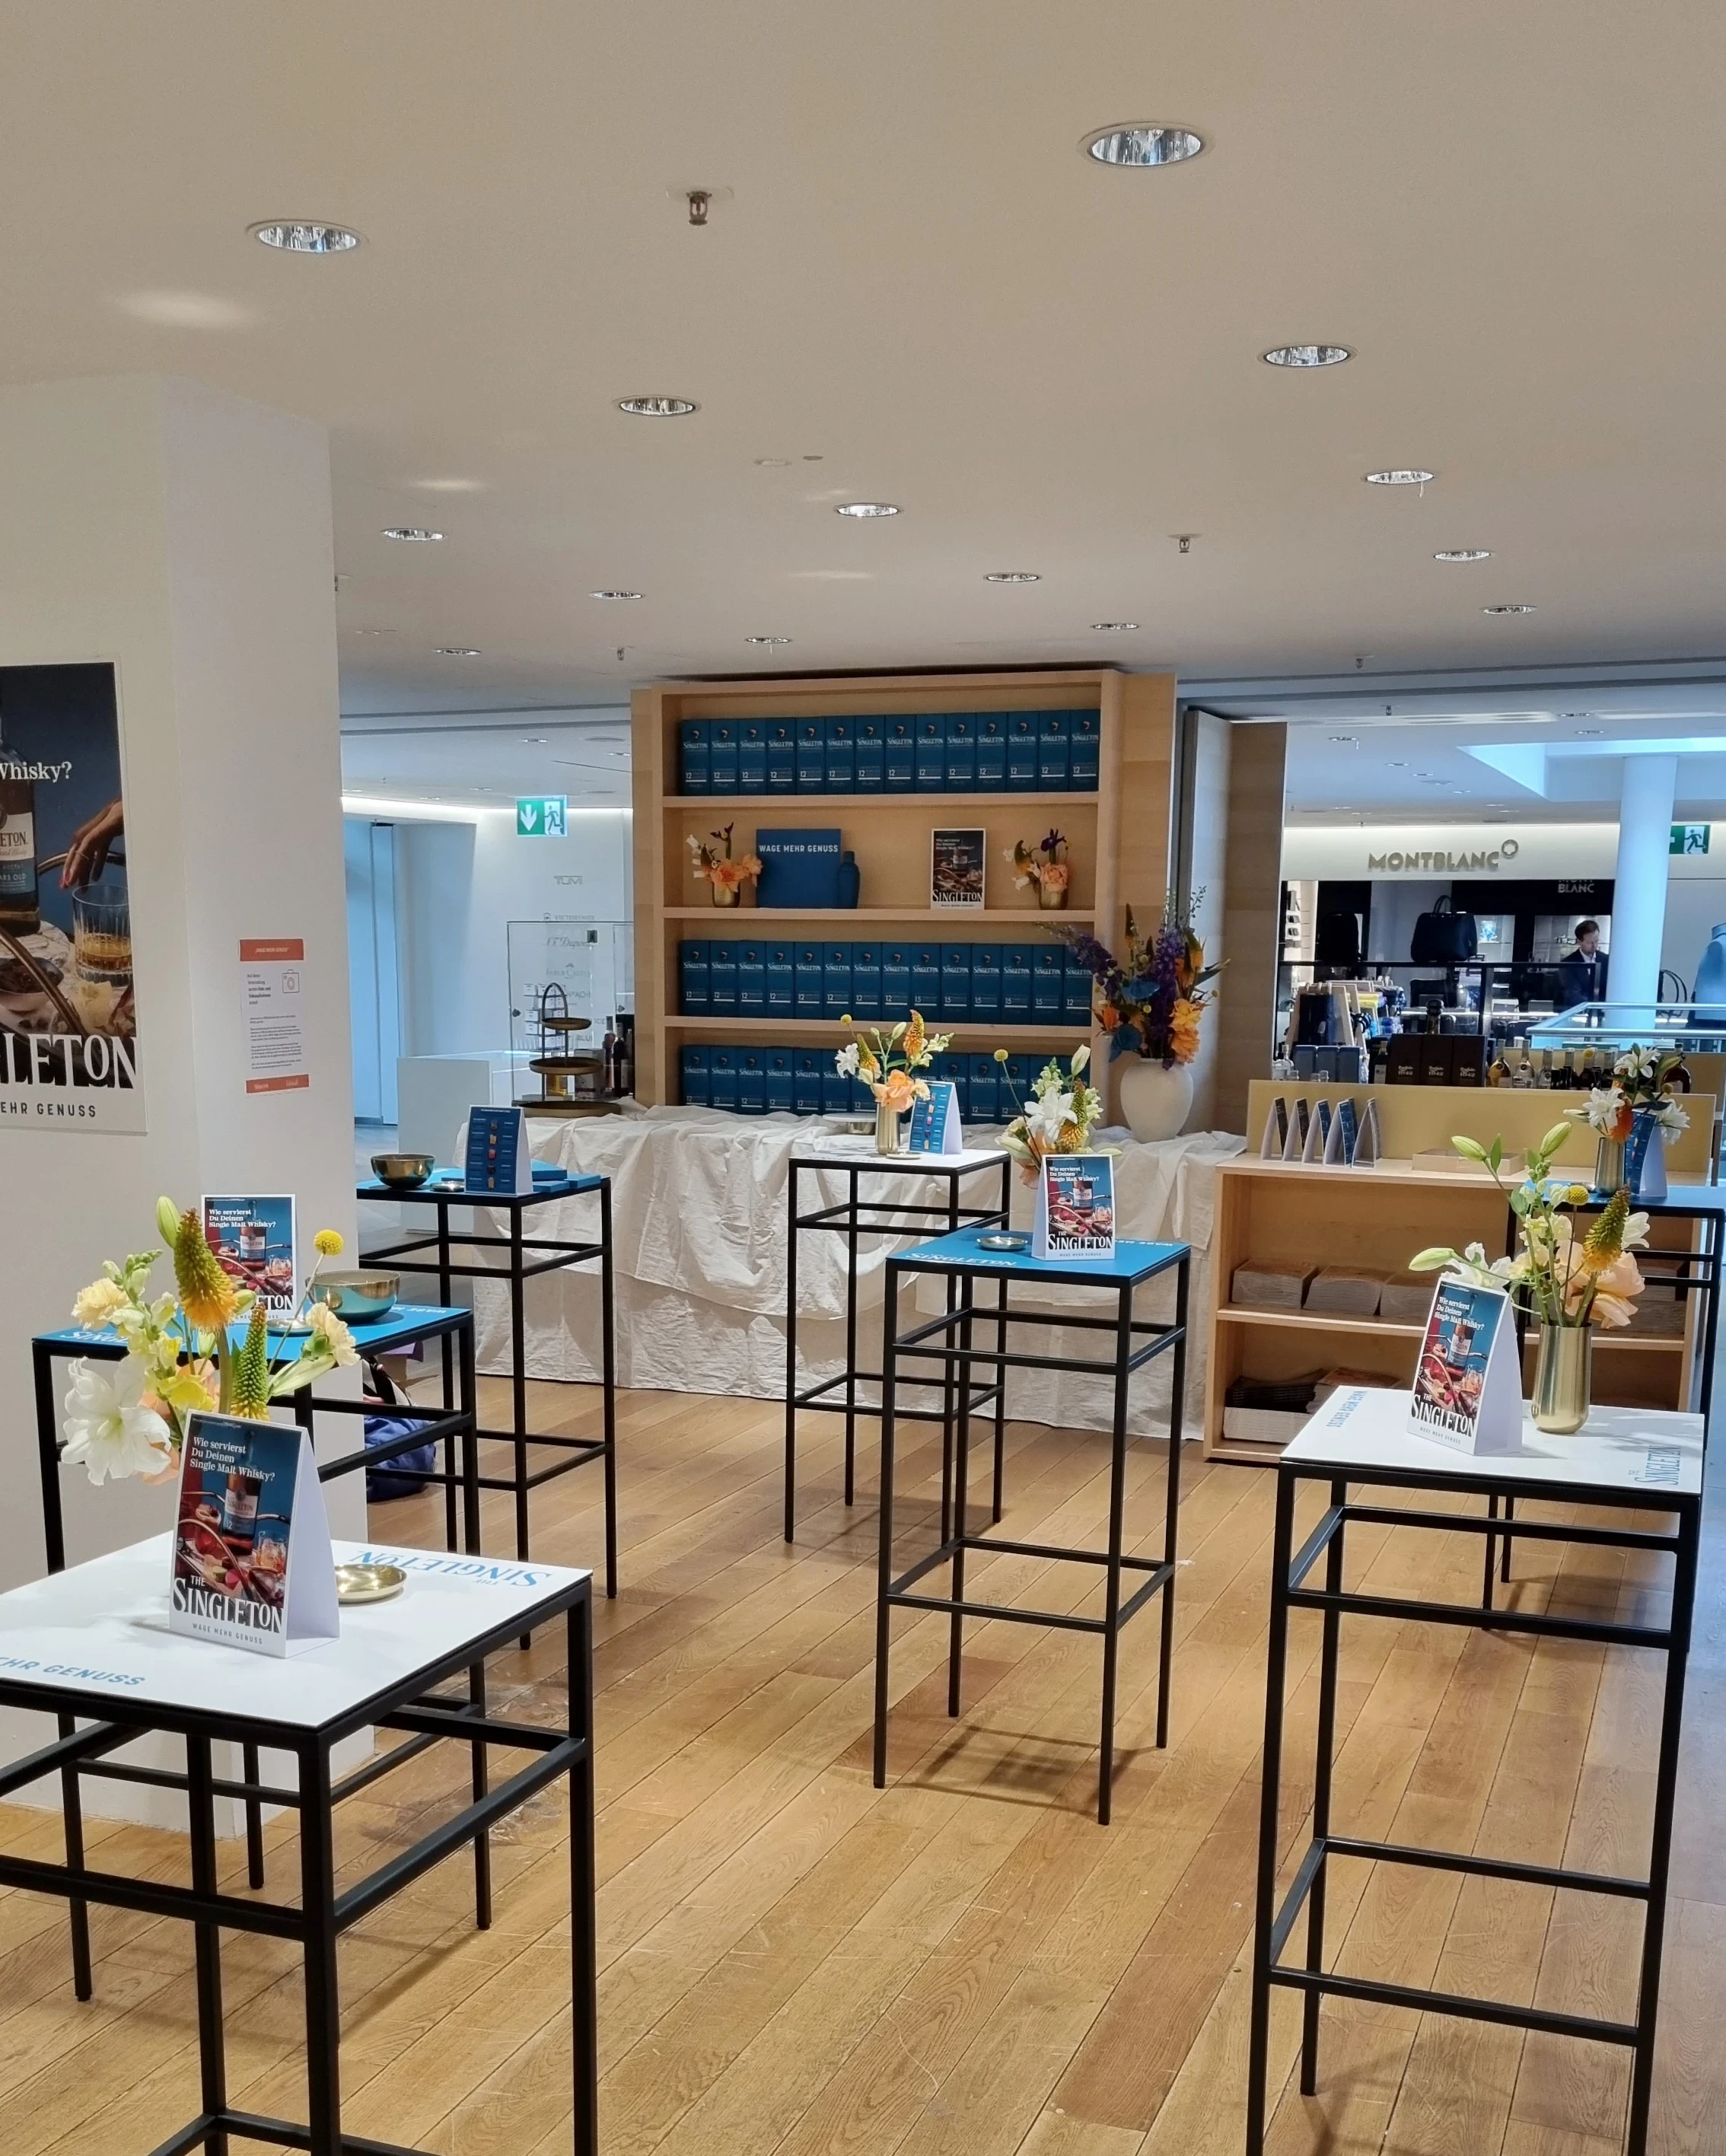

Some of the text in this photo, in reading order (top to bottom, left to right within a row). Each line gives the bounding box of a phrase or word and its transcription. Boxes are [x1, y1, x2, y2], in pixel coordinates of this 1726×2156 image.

[1368, 851, 1499, 871] MONTBLANC
[932, 889, 984, 903] SINGLETON
[1557, 883, 1595, 893] BLANC
[37, 1103, 96, 1117] GENUSS
[1049, 1234, 1112, 1249] SINGLETON
[906, 1253, 1017, 1266] SINGLETON
[1412, 1394, 1476, 1437] SINGLETON
[193, 1436, 247, 1454] Wie servierst
[191, 1447, 235, 1463] Du Deinen
[189, 1458, 275, 1482] Single Malt Whisky?
[1635, 1445, 1681, 1486] SINGLETON
[350, 1551, 552, 1587] SINGLETON
[190, 1575, 206, 1587] THE
[173, 1577, 285, 1634] SINGLETON
[193, 1623, 263, 1644] WAGE MEHR GENUSS
[43, 1664, 145, 1685] GENUSS
